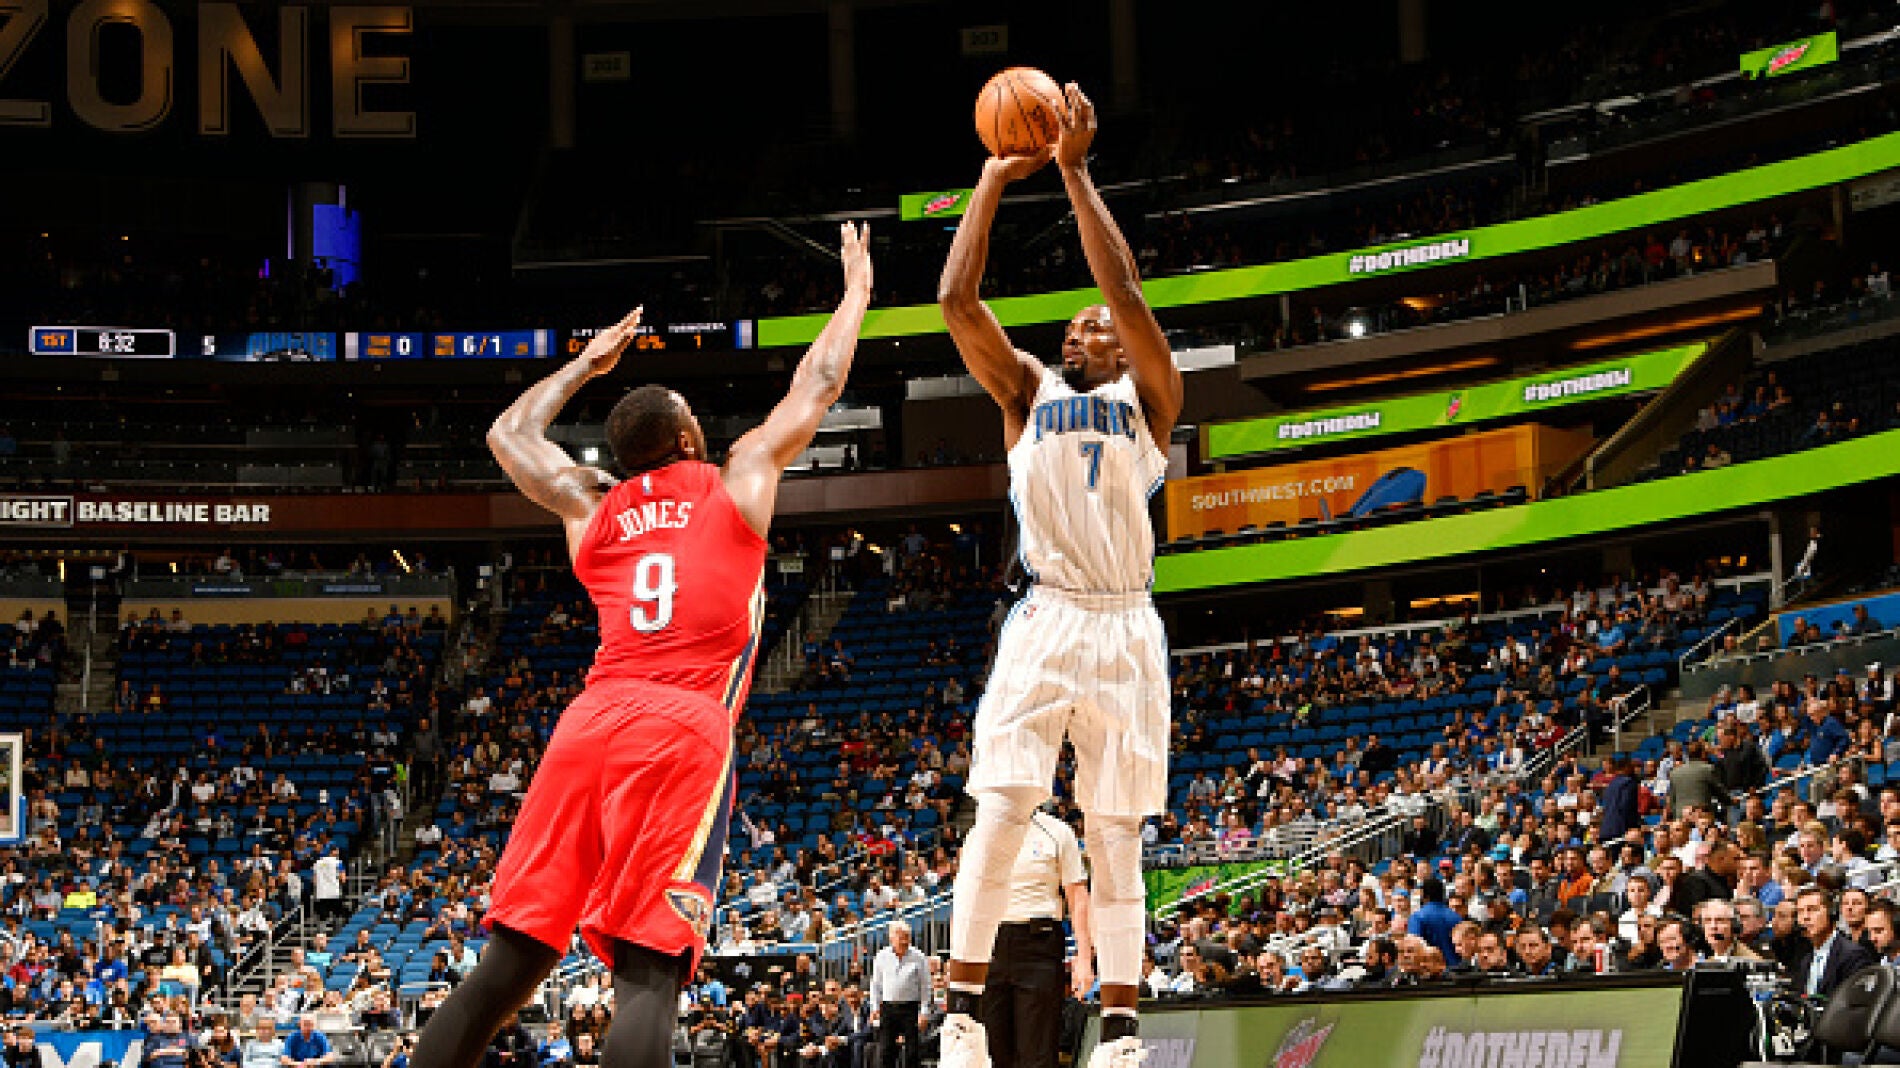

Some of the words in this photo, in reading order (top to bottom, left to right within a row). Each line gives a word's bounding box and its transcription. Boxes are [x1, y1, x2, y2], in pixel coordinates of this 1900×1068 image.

[1349, 239, 1469, 273] #DOTHEDEW
[1523, 367, 1633, 402] #DOTHEDEW
[1034, 395, 1137, 443] MAGIC
[1278, 411, 1381, 439] #DOTHEDEW
[1080, 440, 1104, 491] 7
[77, 501, 209, 522] BASELINE
[213, 504, 270, 522] BAR
[1191, 474, 1355, 512] SOUTHWEST.COM
[616, 498, 693, 541] JONES
[629, 551, 679, 633] 9
